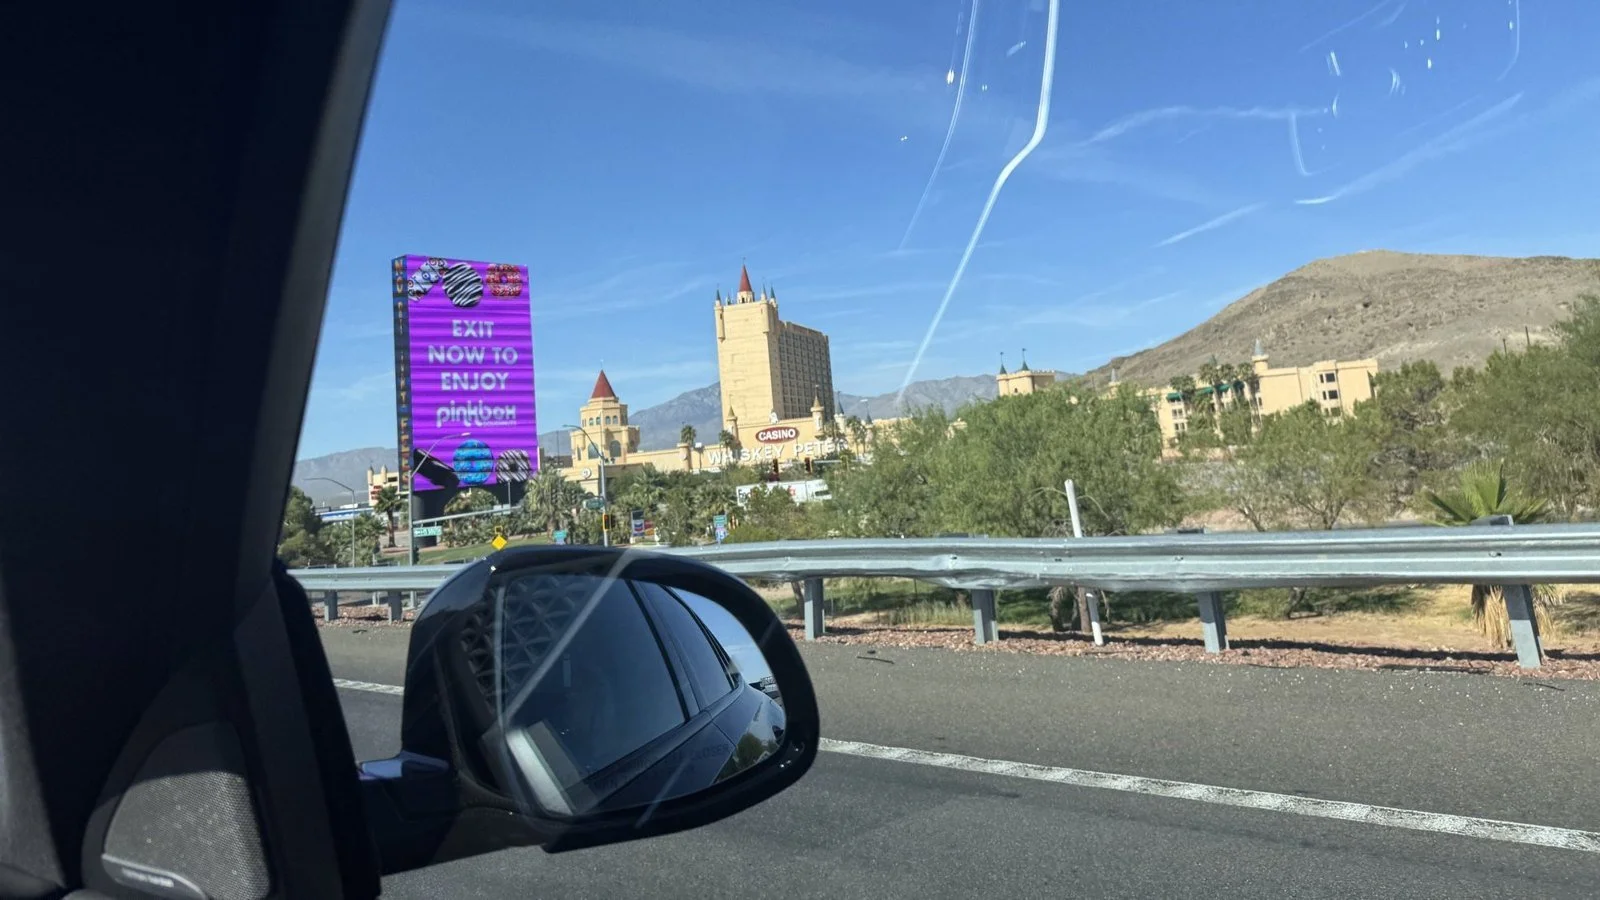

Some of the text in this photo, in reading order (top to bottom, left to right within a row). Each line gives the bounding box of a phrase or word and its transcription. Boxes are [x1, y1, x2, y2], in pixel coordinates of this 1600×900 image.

[452, 319, 494, 338] EXIT
[428, 344, 518, 365] NOW TO
[440, 371, 509, 391] ENJOY
[758, 428, 796, 441] CASINO
[707, 444, 785, 465] WHISKEY
